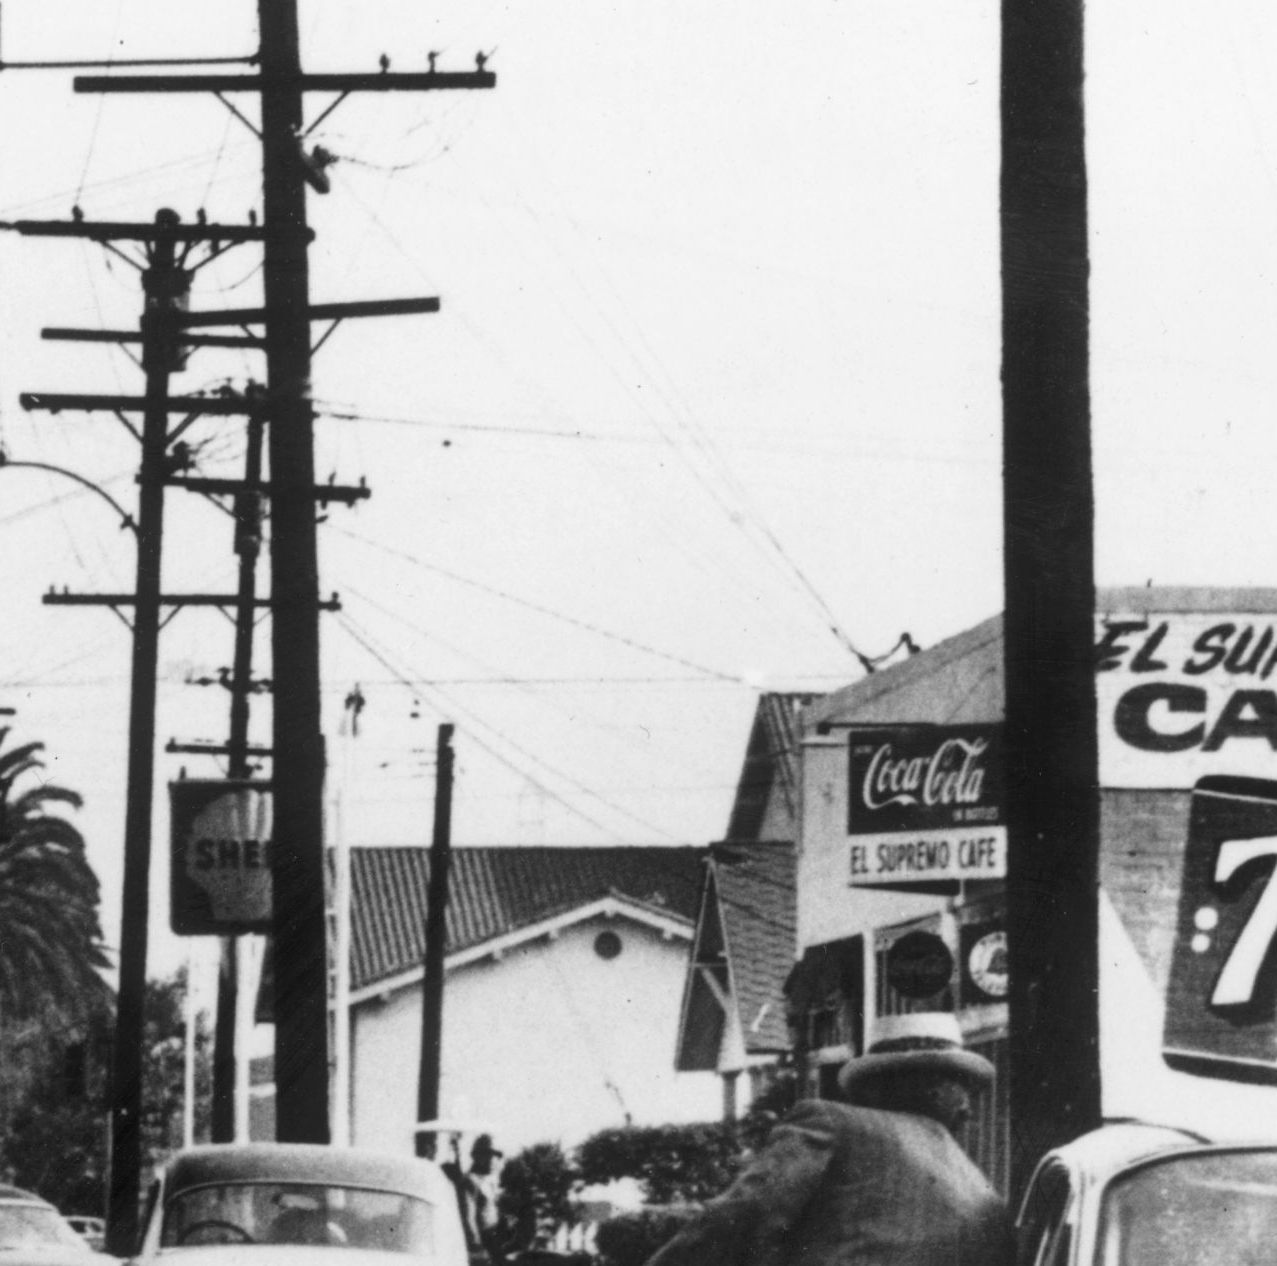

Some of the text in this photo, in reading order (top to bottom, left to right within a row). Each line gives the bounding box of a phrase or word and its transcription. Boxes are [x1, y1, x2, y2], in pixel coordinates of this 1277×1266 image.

[1096, 621, 1168, 673] EL
[1113, 681, 1277, 753] CA
[863, 738, 989, 809] Coca-Cola
[195, 839, 271, 870] SHE
[850, 837, 996, 875] EL SUPREMO CAFE
